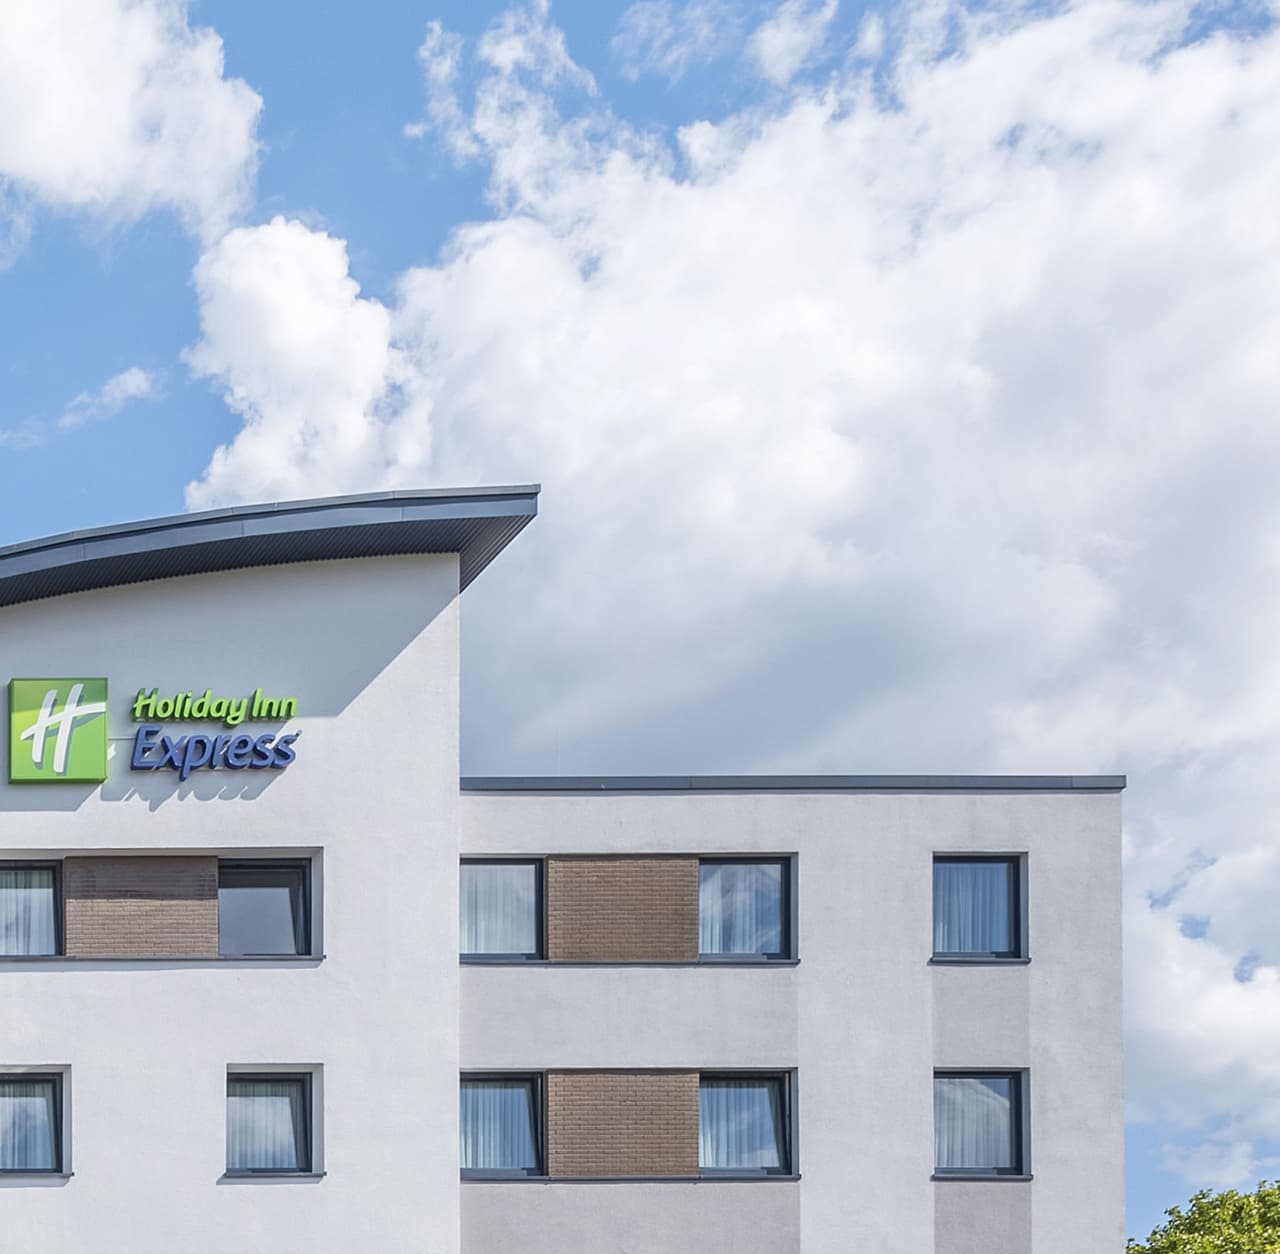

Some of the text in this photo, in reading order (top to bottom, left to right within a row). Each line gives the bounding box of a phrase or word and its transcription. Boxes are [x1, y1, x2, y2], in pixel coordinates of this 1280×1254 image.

[20, 683, 107, 774] H
[132, 687, 298, 727] Holiday Inn
[132, 724, 299, 781] Express
